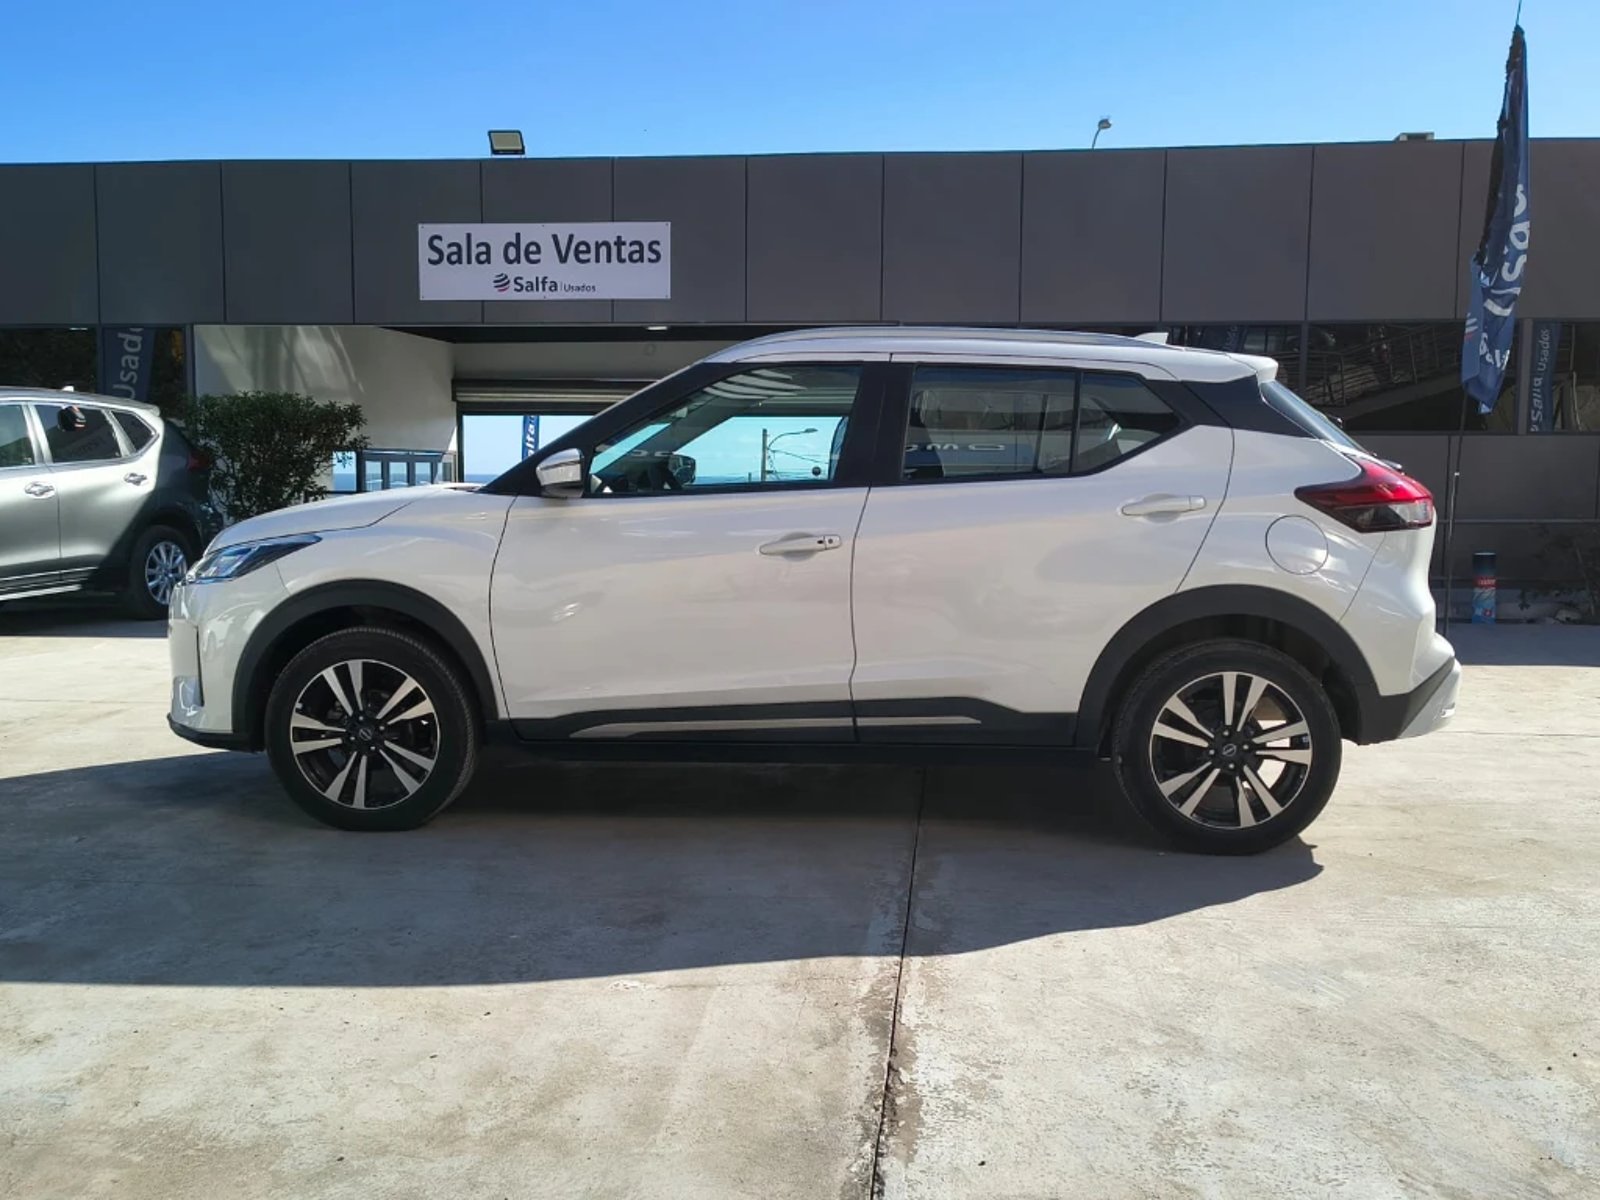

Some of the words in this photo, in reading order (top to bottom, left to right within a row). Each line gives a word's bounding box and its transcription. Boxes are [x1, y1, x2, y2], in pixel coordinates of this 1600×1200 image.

[427, 232, 491, 265] Sala
[502, 232, 542, 265] de
[551, 233, 662, 265] Ventas
[513, 275, 558, 293] Salfa
[563, 283, 596, 293] Usados
[1537, 328, 1550, 372] Usados
